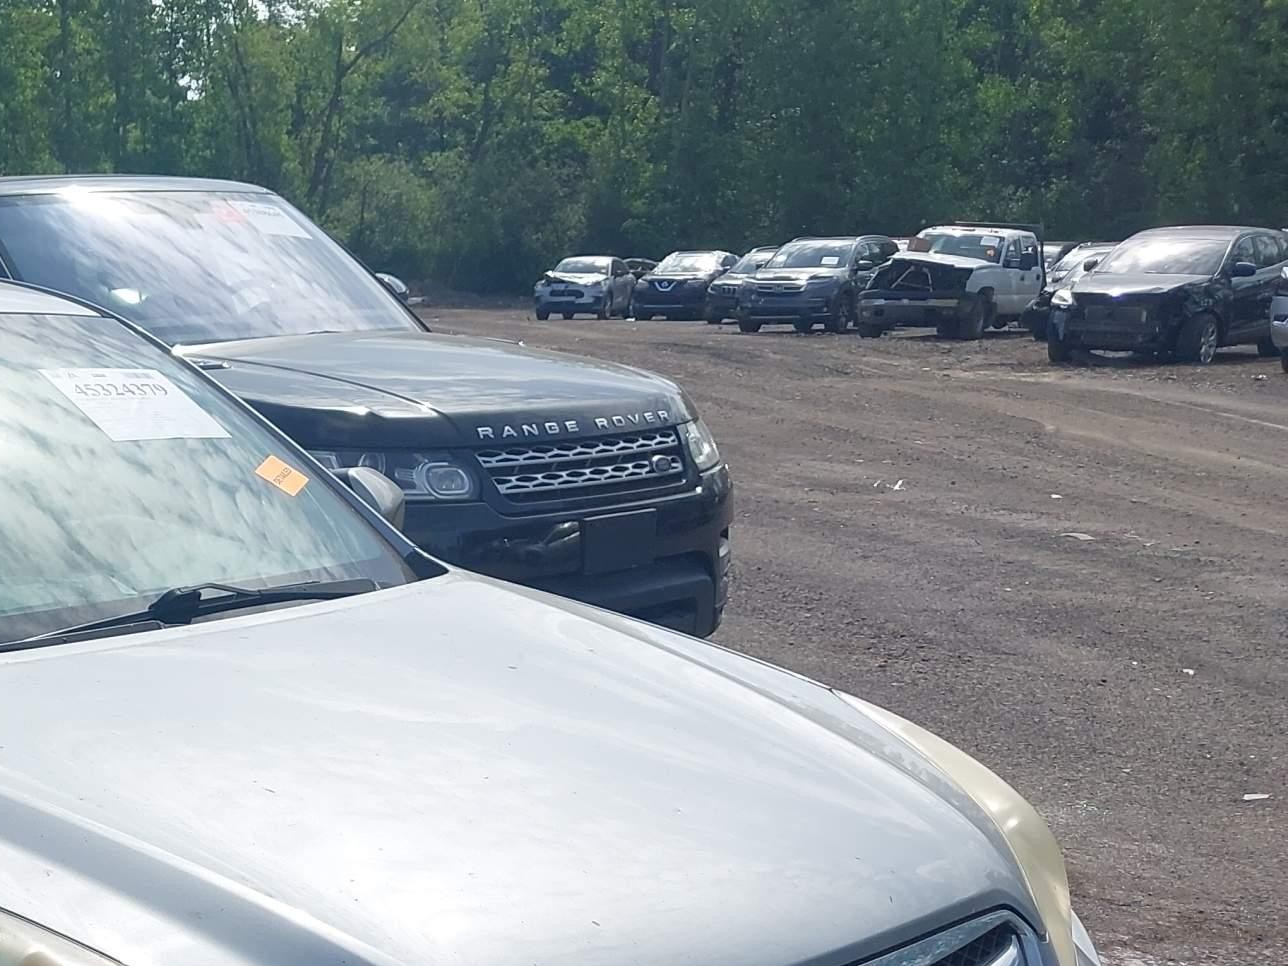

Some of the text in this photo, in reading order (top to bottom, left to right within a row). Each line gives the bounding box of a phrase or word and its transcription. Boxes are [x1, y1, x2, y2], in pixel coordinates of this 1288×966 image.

[74, 383, 168, 397] 45324379
[476, 410, 670, 440] RANGE ROVER
